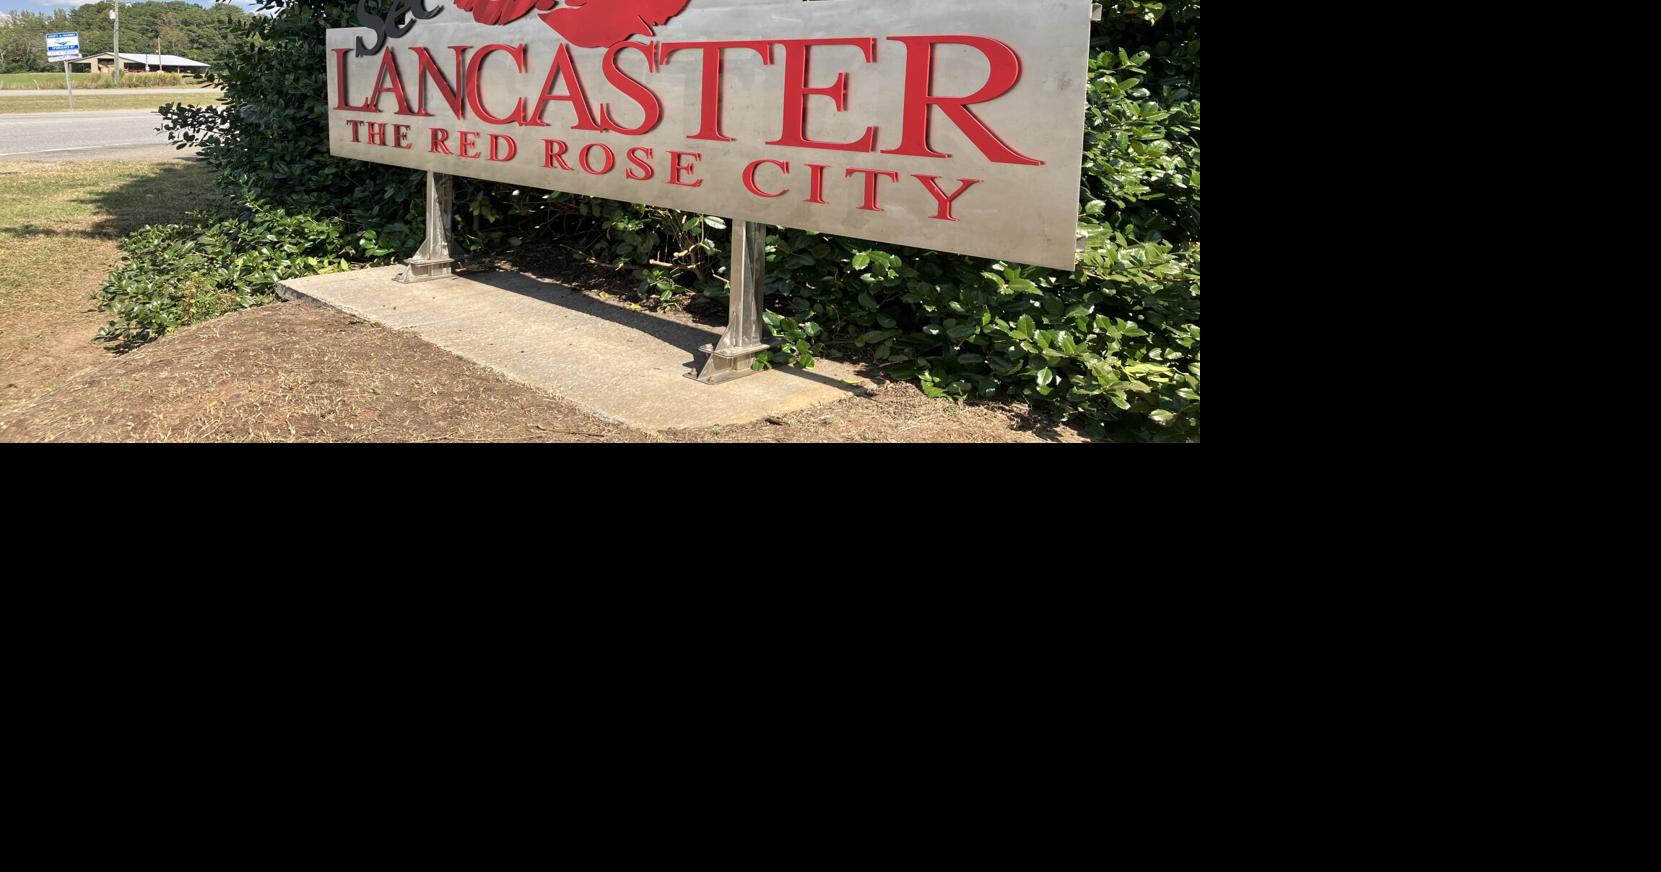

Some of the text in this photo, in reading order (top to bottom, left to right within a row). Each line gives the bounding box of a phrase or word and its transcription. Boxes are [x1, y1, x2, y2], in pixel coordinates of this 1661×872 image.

[331, 34, 1045, 166] LANCASTER
[345, 119, 984, 222] THE RED ROSE CITY
